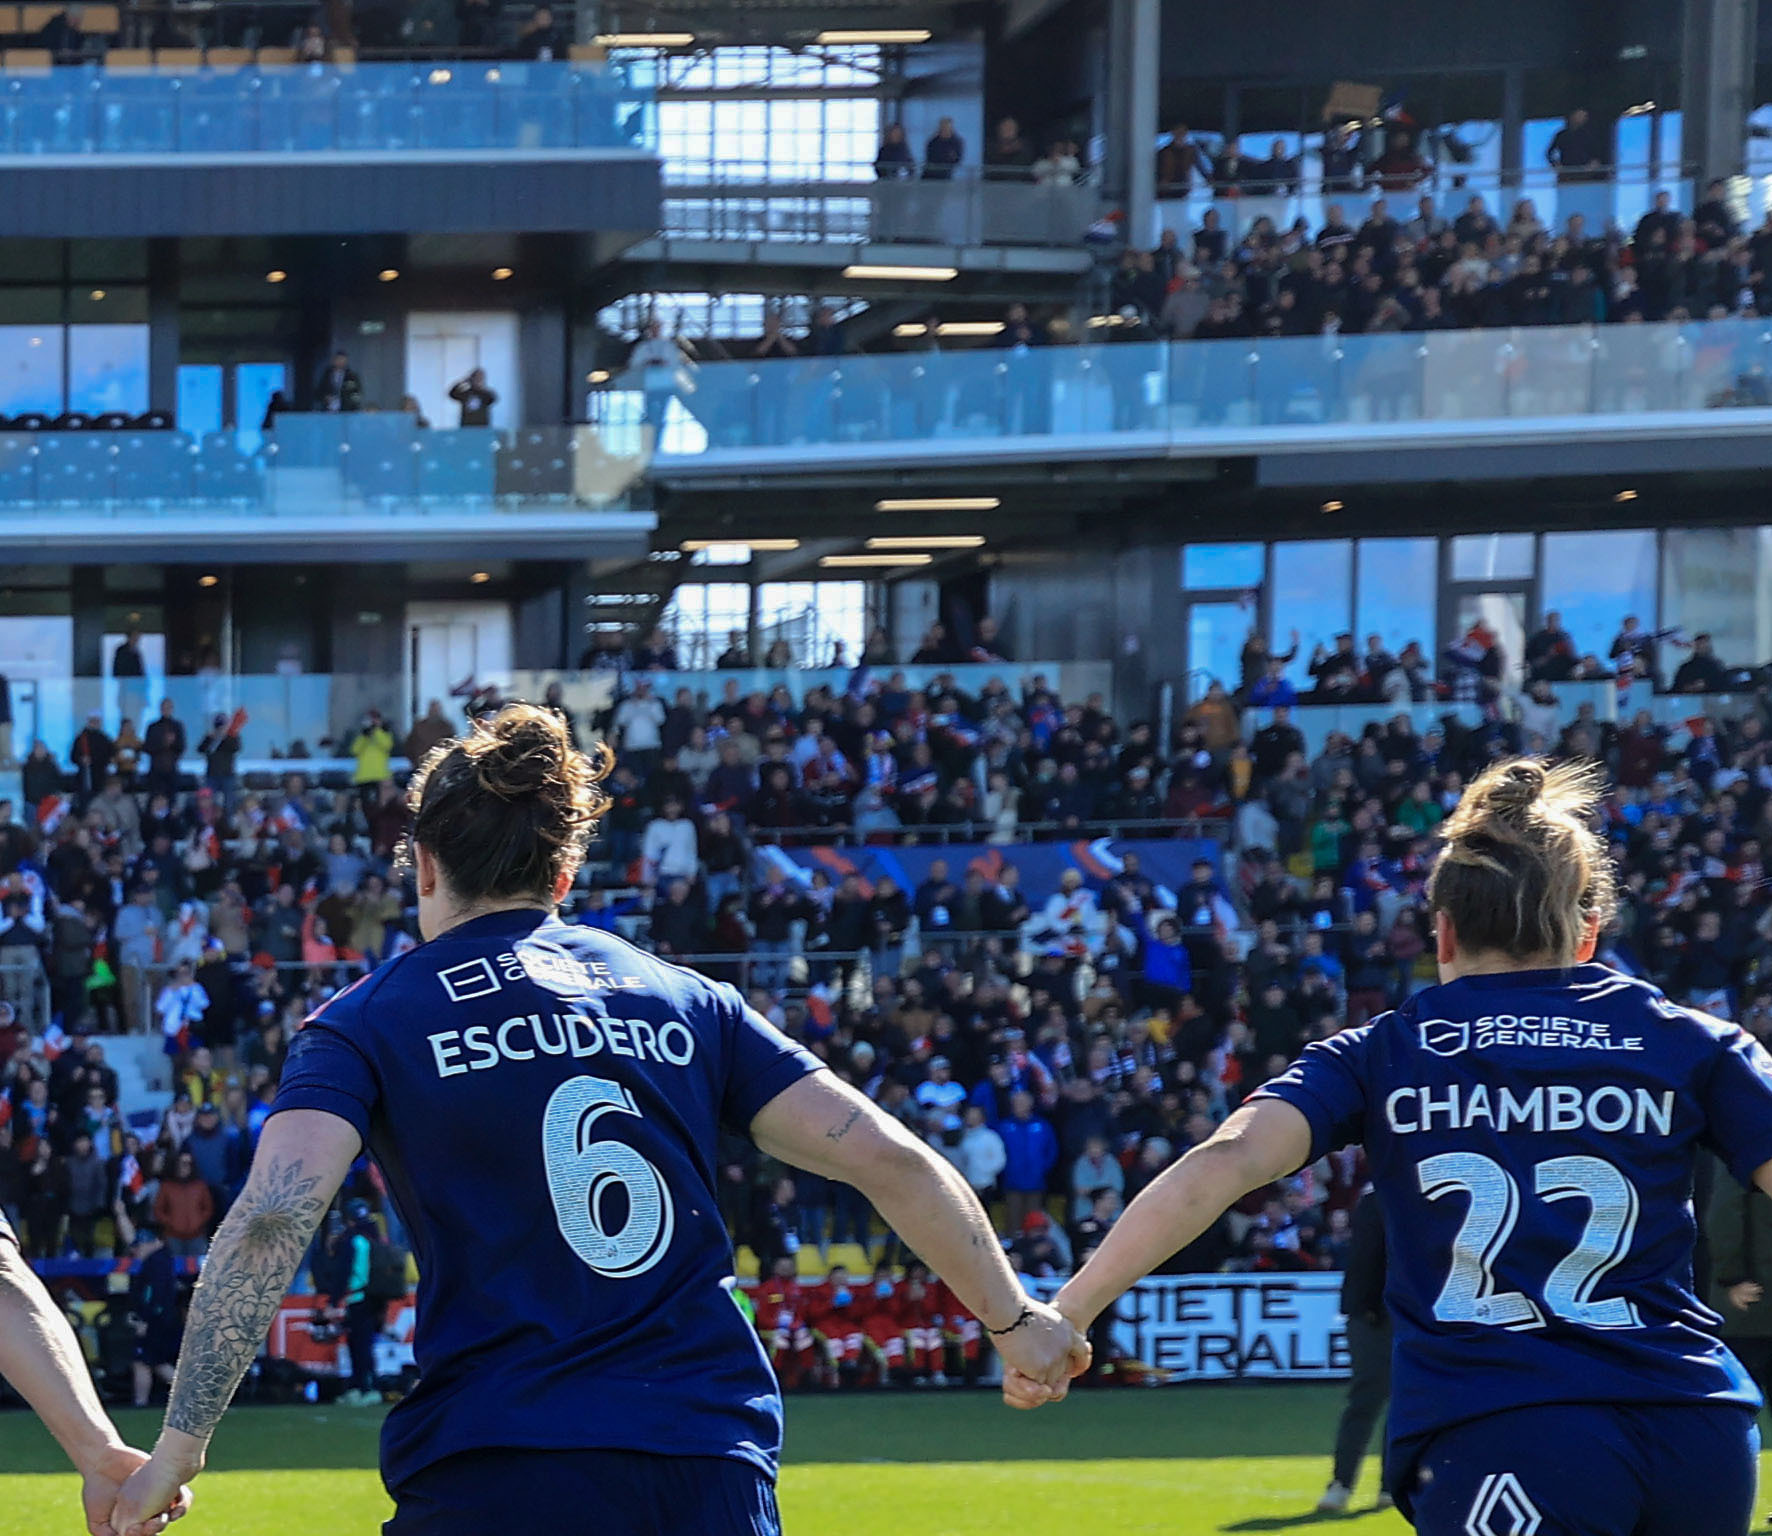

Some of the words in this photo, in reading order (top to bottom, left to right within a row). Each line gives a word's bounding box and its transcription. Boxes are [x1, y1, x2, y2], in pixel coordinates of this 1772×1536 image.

[426, 1013, 695, 1078] ESCUDERO
[1475, 1014, 1611, 1037] SOCIETE
[1475, 1029, 1645, 1051] GENERALE
[1385, 1083, 1676, 1136] CHAMBON
[542, 1075, 675, 1279] 6
[1416, 1152, 1647, 1332] 22
[1108, 1284, 1299, 1322] CIETE
